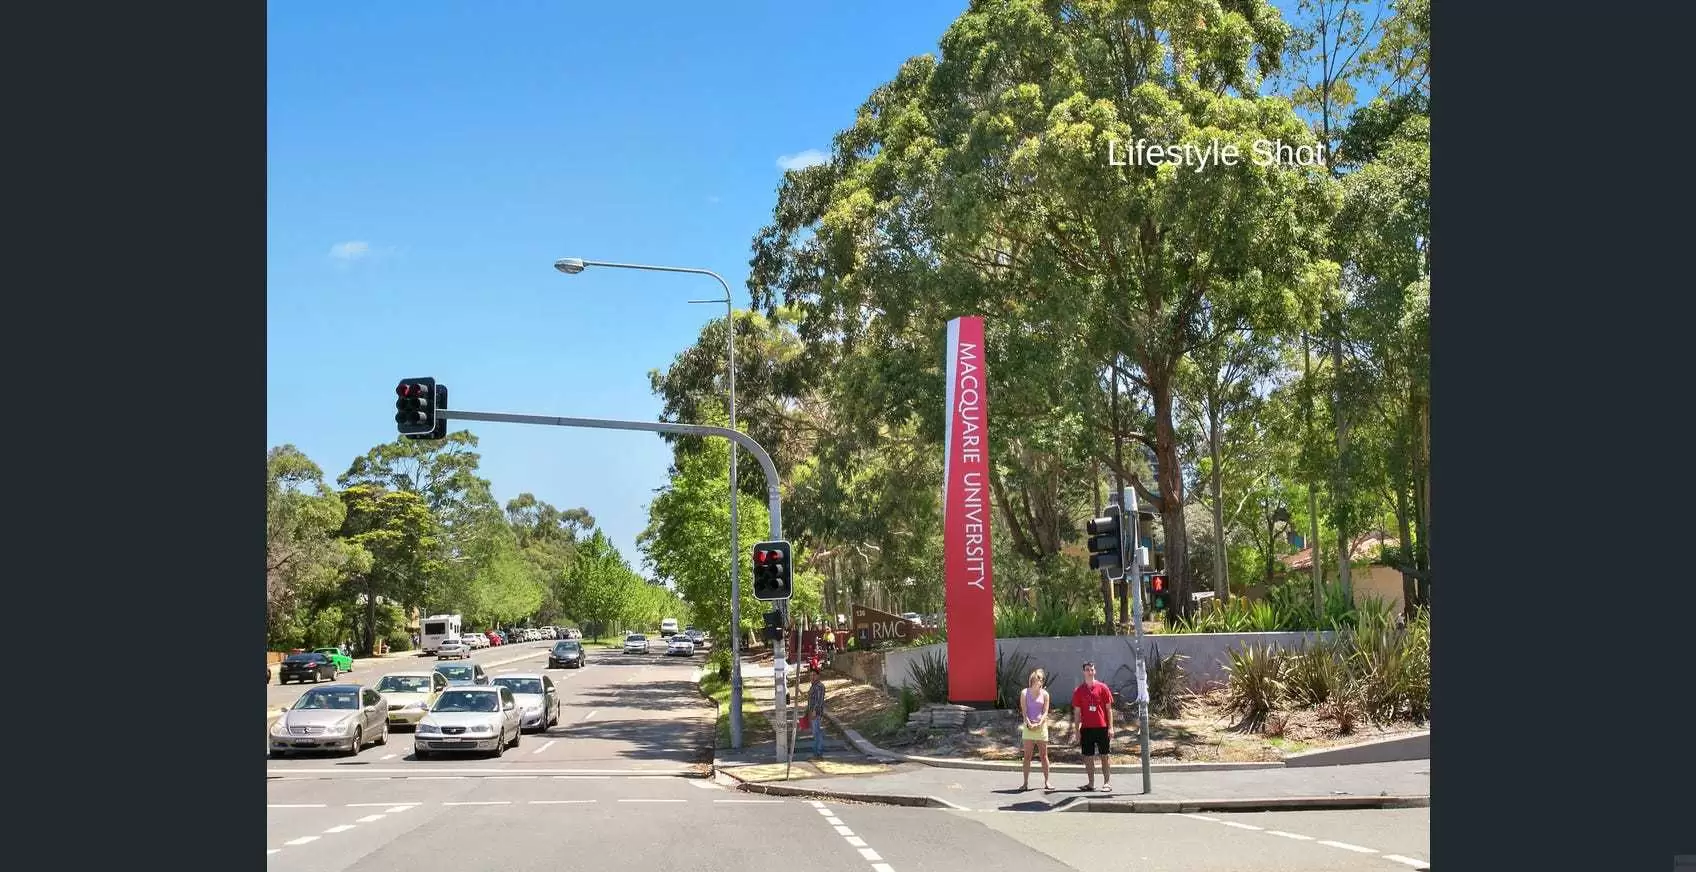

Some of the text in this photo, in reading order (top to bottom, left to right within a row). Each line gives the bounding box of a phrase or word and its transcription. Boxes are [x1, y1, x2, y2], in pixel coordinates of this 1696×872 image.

[958, 343, 985, 590] MACQUARIE UNIVERSITY
[872, 620, 906, 639] RMC
